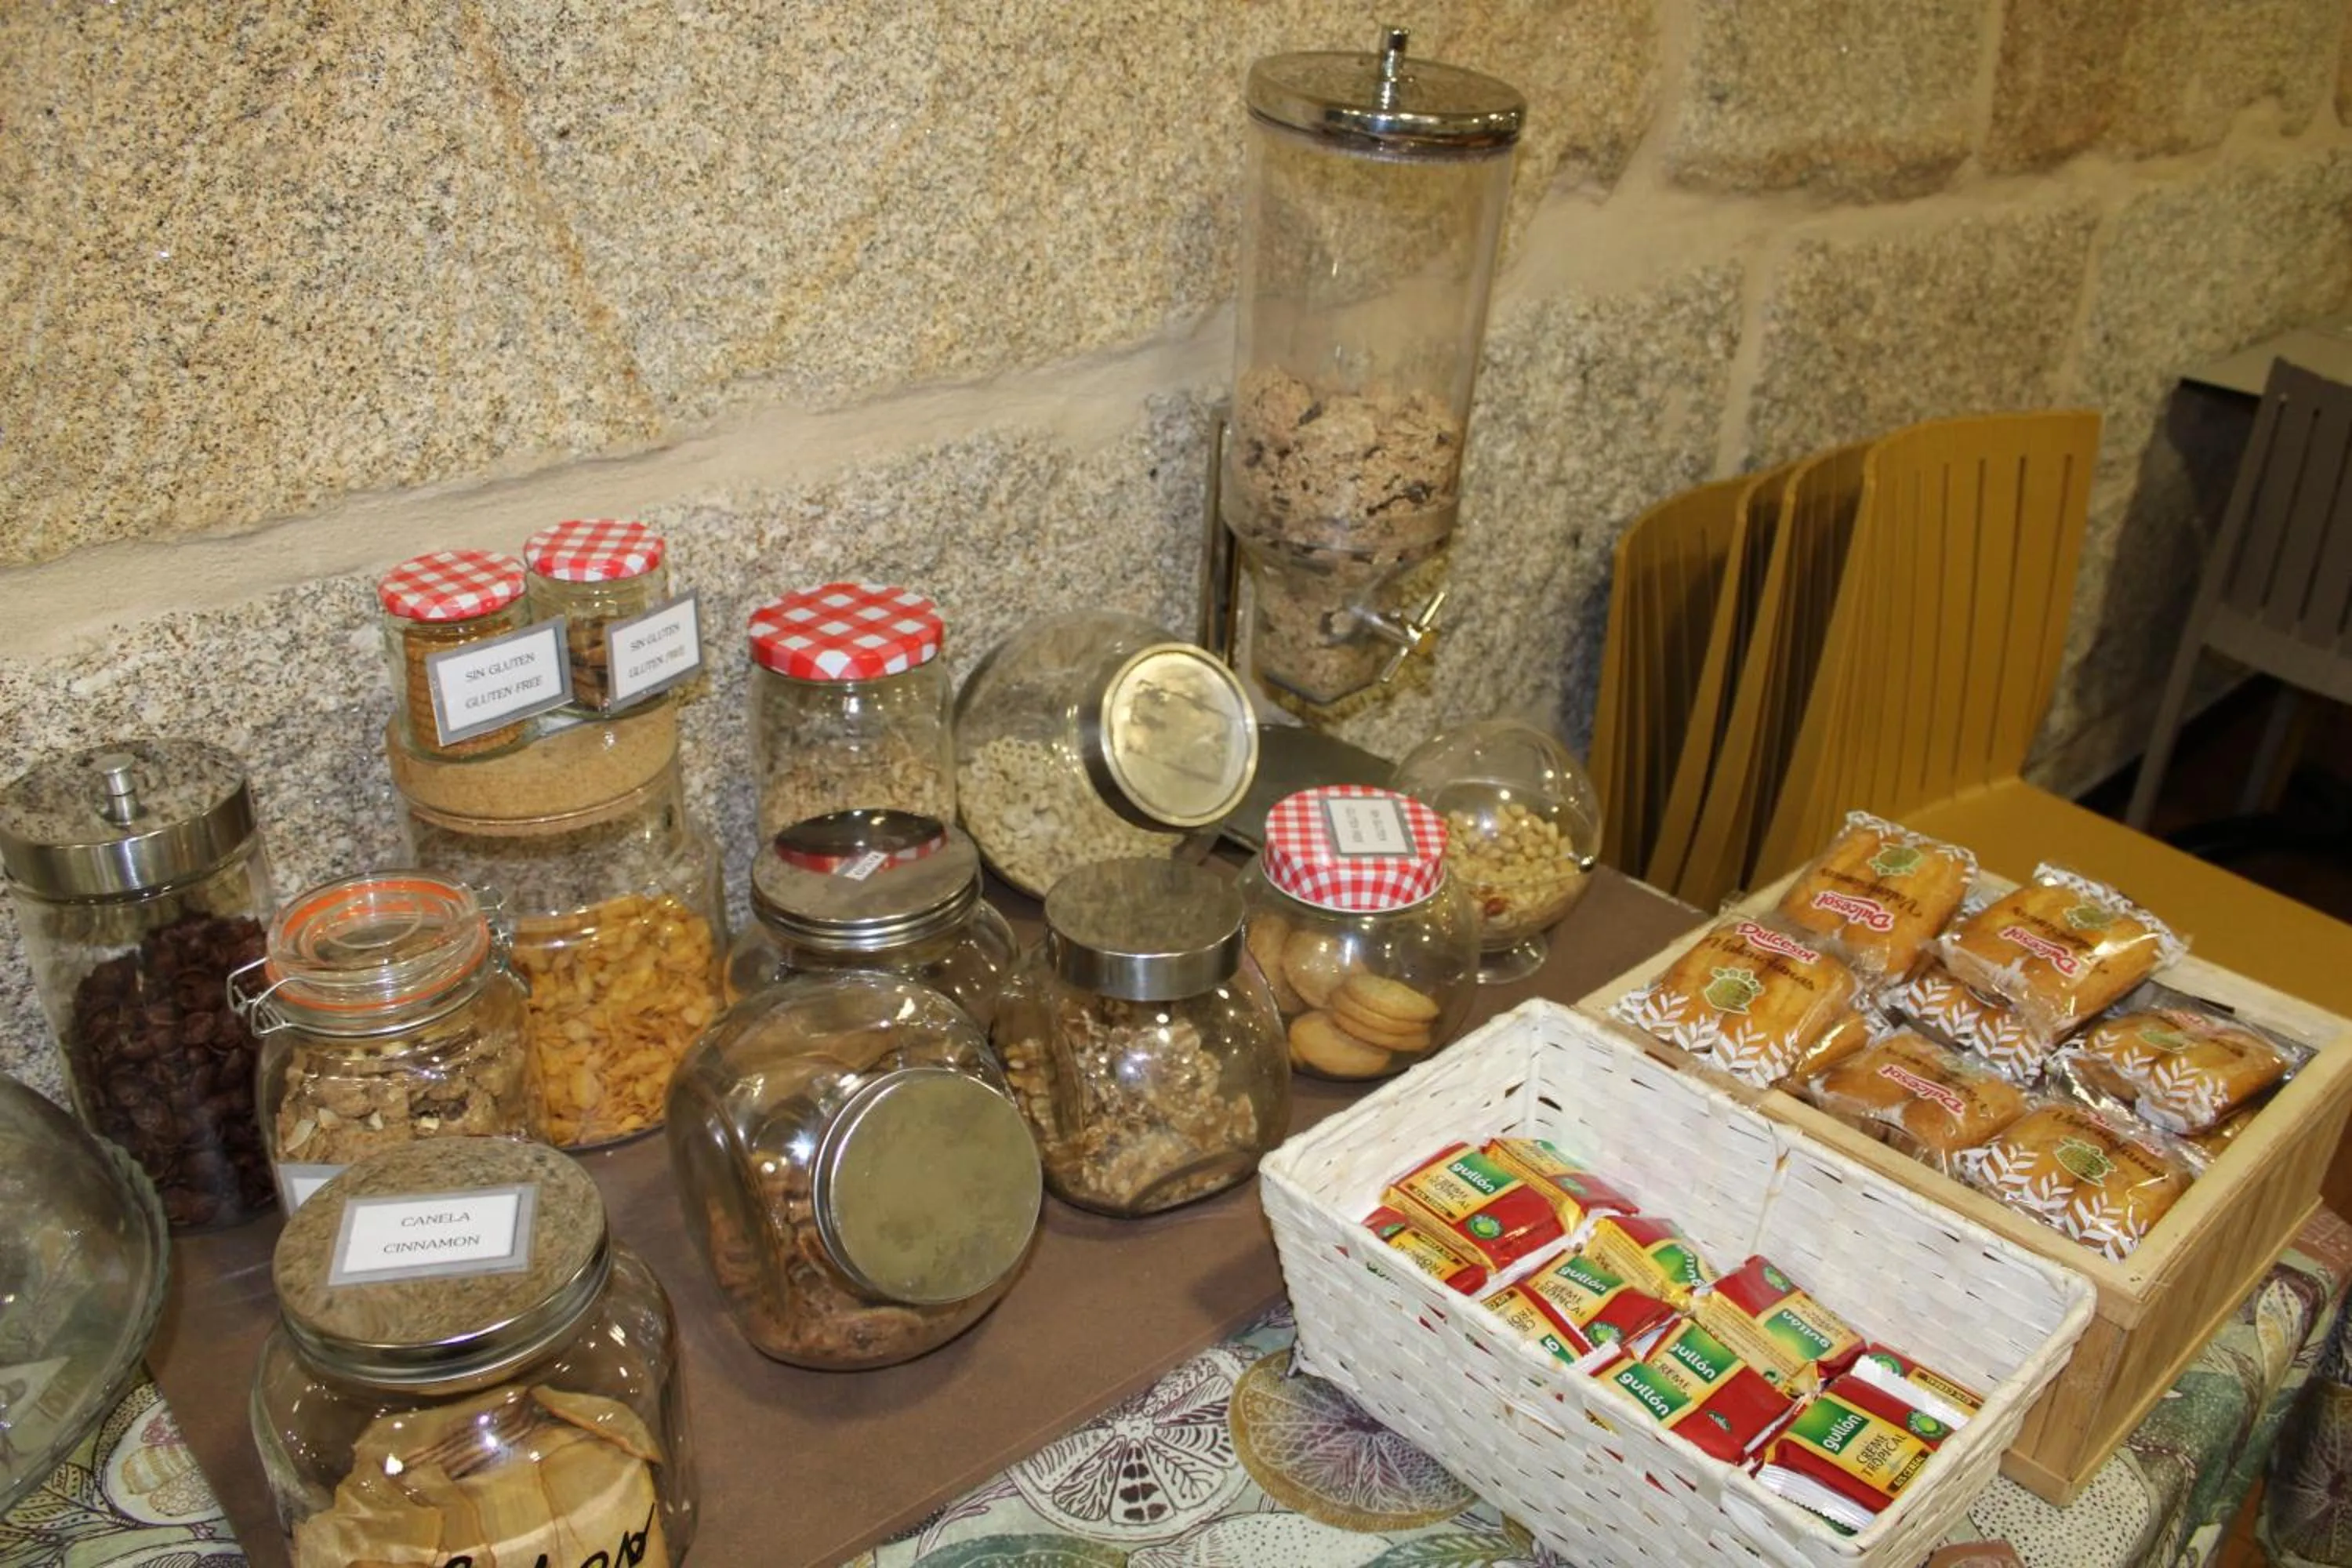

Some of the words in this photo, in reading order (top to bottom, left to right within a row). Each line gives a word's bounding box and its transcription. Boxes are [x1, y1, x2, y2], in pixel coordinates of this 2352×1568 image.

[630, 637, 645, 652] SIN
[647, 622, 681, 644] GLUTEN
[465, 666, 485, 681] SIN
[488, 652, 536, 675] GLUTEN
[629, 655, 663, 678] GLUTEN
[465, 686, 512, 709] GLUTEN
[514, 674, 543, 693] FREE
[1814, 891, 1892, 931] Dulcesol
[1738, 921, 1819, 962] Dulcesol
[2001, 927, 2079, 975] Dulcesol
[1880, 1064, 1964, 1115] Dulcesol
[1450, 1162, 1496, 1193] gullón
[401, 1212, 470, 1227] CANELA
[383, 1234, 481, 1254] CINNAMON
[1557, 1265, 1607, 1292] gullón
[1618, 1371, 1670, 1416] gullón
[1822, 1414, 1864, 1452] gullón
[1861, 1433, 1907, 1478] TROPICAL
